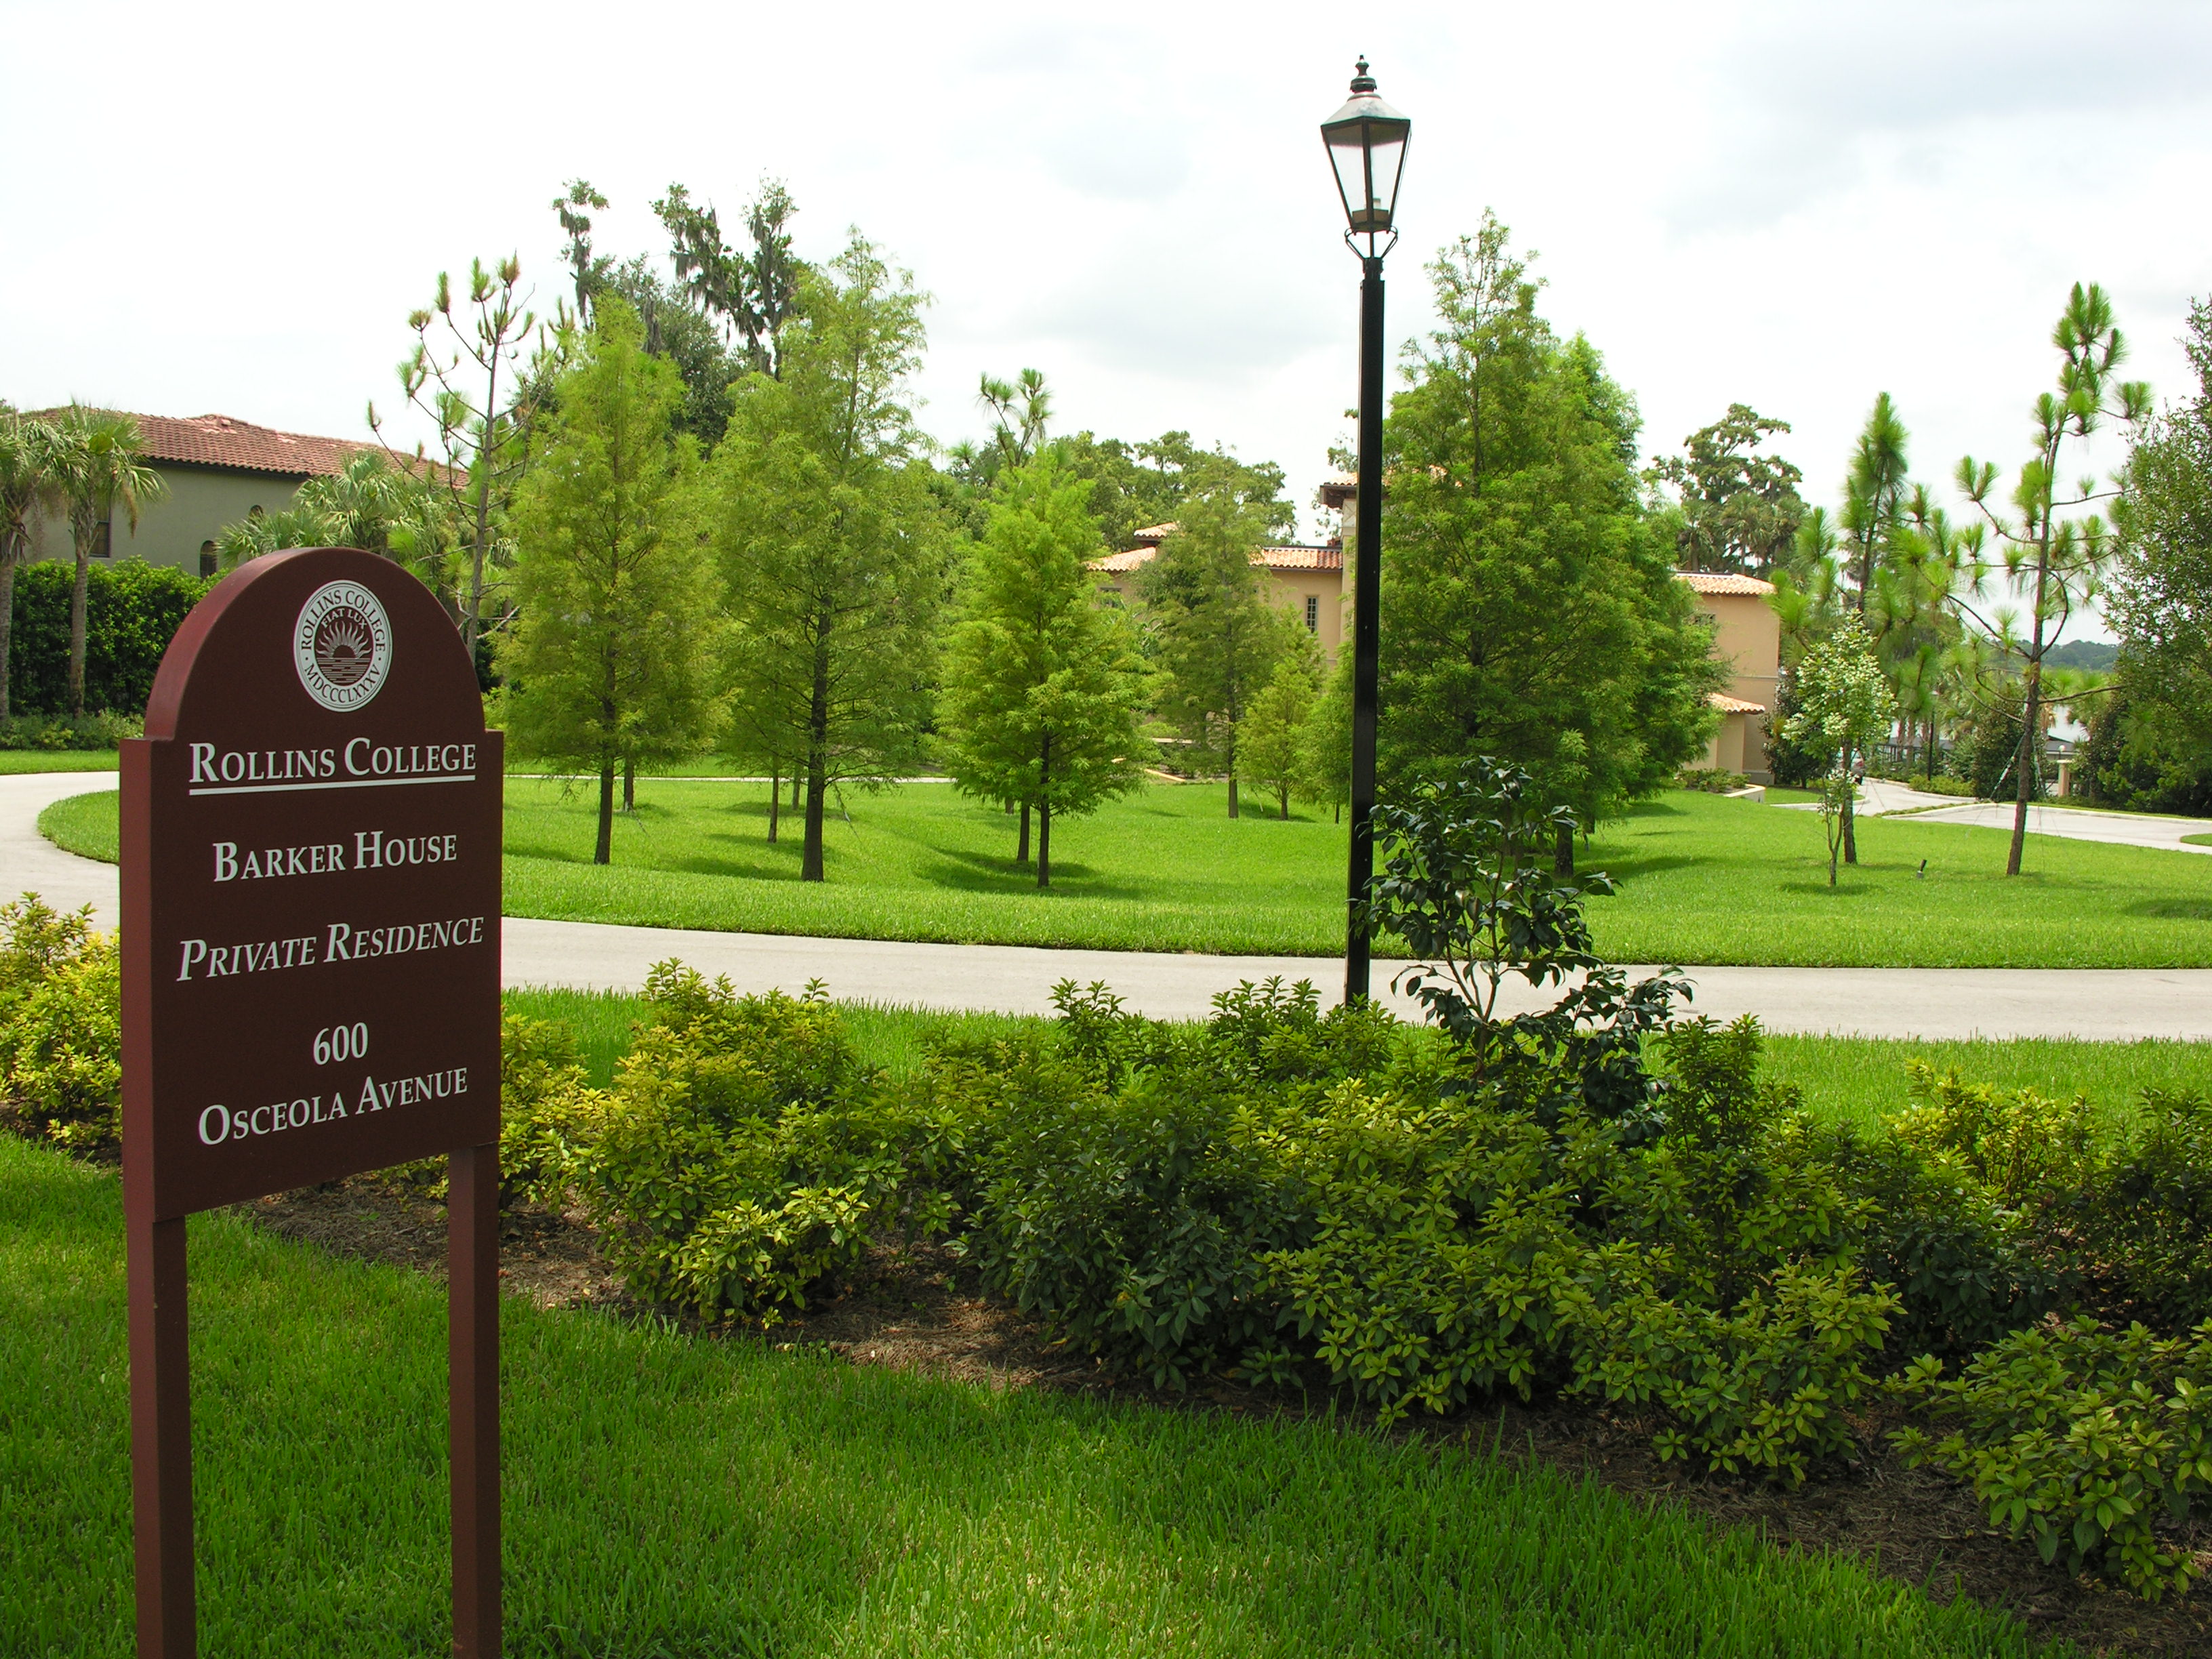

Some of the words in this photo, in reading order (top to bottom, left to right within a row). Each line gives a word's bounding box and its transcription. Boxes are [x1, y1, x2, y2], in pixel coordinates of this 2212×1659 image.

[301, 590, 342, 651] ROLLINS
[346, 590, 386, 652] COLLEGE
[321, 609, 345, 628] FIAT
[348, 610, 367, 630] LUX
[304, 663, 380, 703] MDCCCLXXXV
[189, 743, 336, 783] ROLLINS
[344, 737, 476, 775] COLLEGE
[213, 841, 346, 882] BARKER
[354, 831, 457, 869] HOUSE
[176, 937, 316, 981] PRIVATE
[323, 917, 484, 962] RESIDENCE
[312, 1022, 368, 1065] 600
[199, 1092, 348, 1145] OSCEOLA
[356, 1067, 467, 1115] AVENUE
